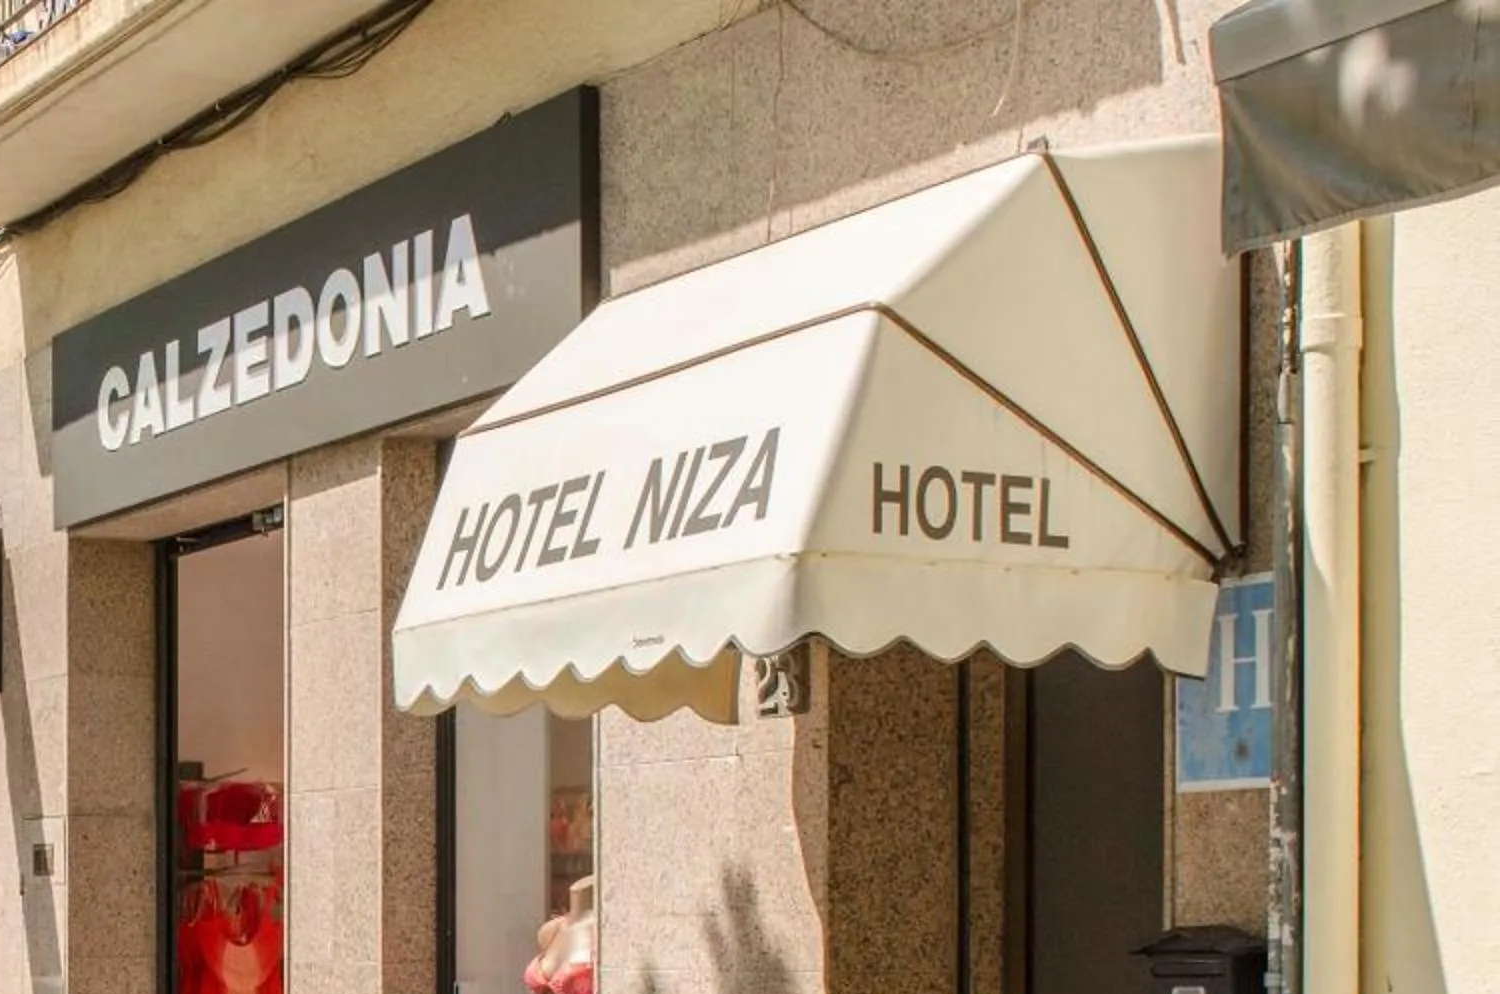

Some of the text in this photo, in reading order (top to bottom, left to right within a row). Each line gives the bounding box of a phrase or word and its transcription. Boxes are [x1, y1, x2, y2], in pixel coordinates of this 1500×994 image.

[98, 213, 492, 451] CALZEDONIA
[435, 426, 781, 591] HOTEL NIZA
[872, 462, 1070, 549] HOTEL
